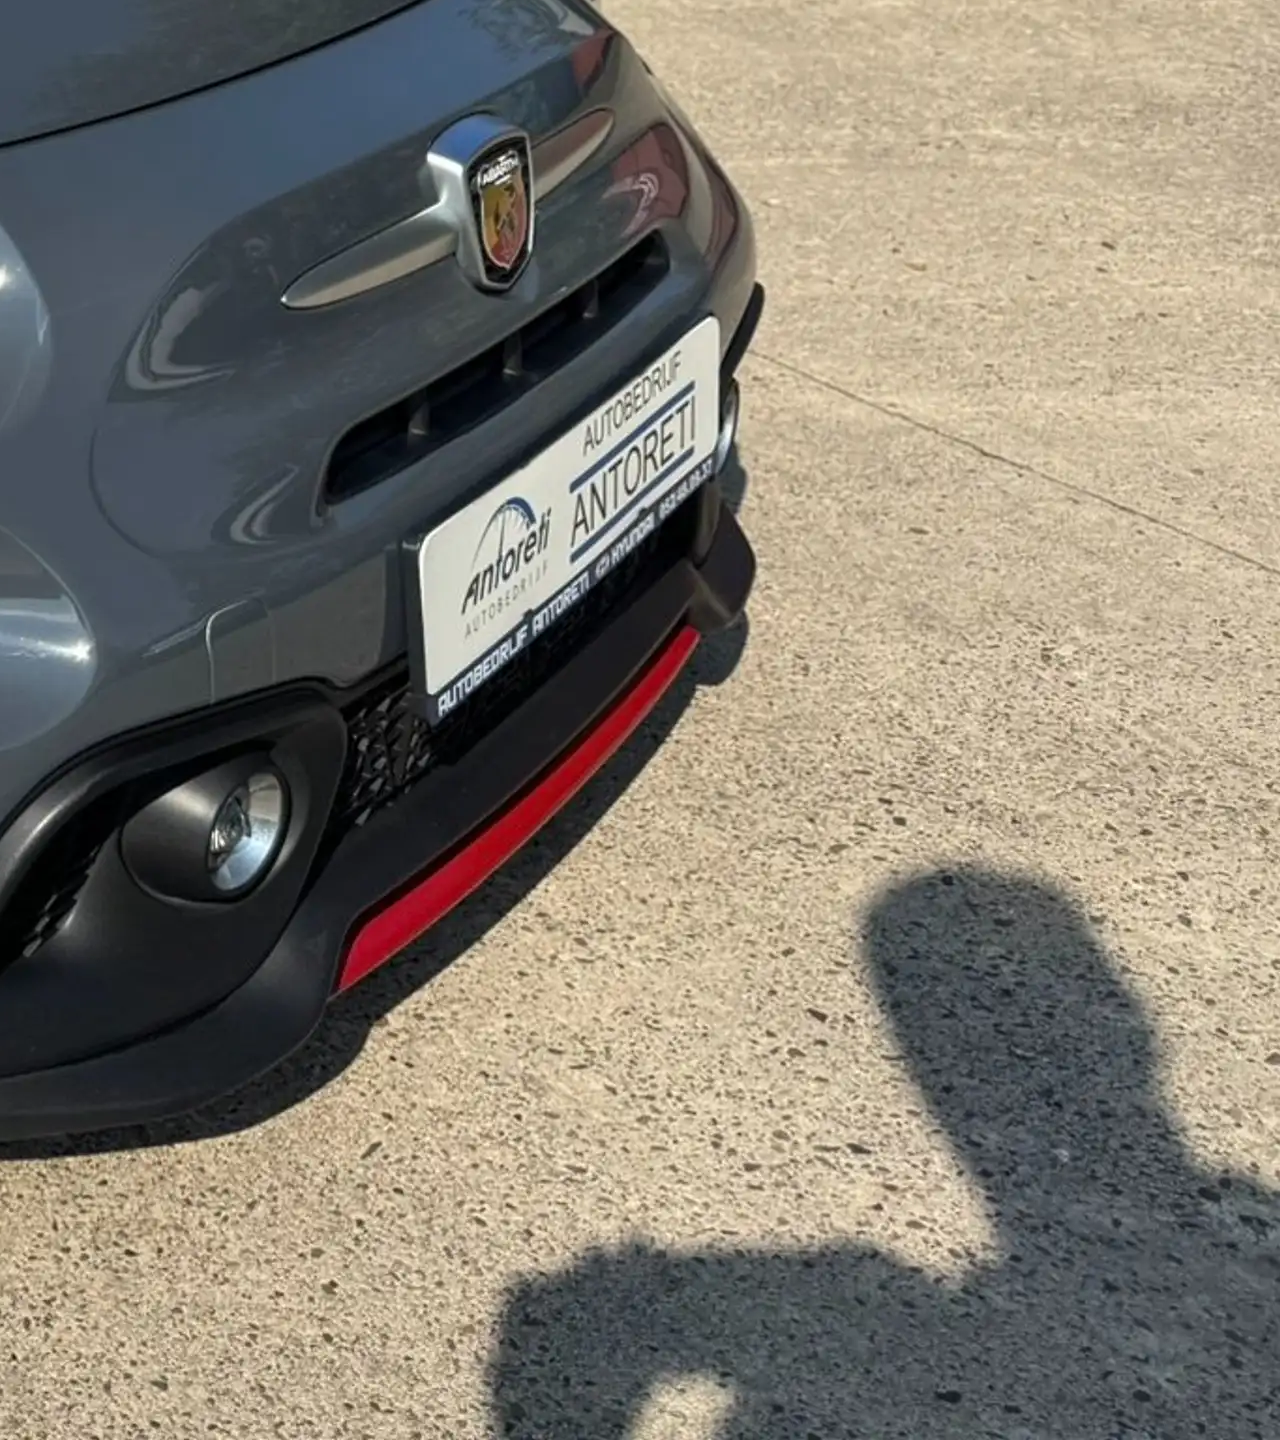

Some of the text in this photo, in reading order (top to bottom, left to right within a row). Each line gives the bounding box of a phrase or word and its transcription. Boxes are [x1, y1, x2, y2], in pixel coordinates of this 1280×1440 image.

[582, 350, 682, 456] AUTOBEDRIJF
[570, 395, 696, 548] ANTORETI
[461, 506, 552, 615] Antoreti
[463, 559, 550, 640] AUTOBEDRIJF
[438, 623, 529, 718] AUTOBEDRIJF
[532, 571, 590, 637] ANTORETI
